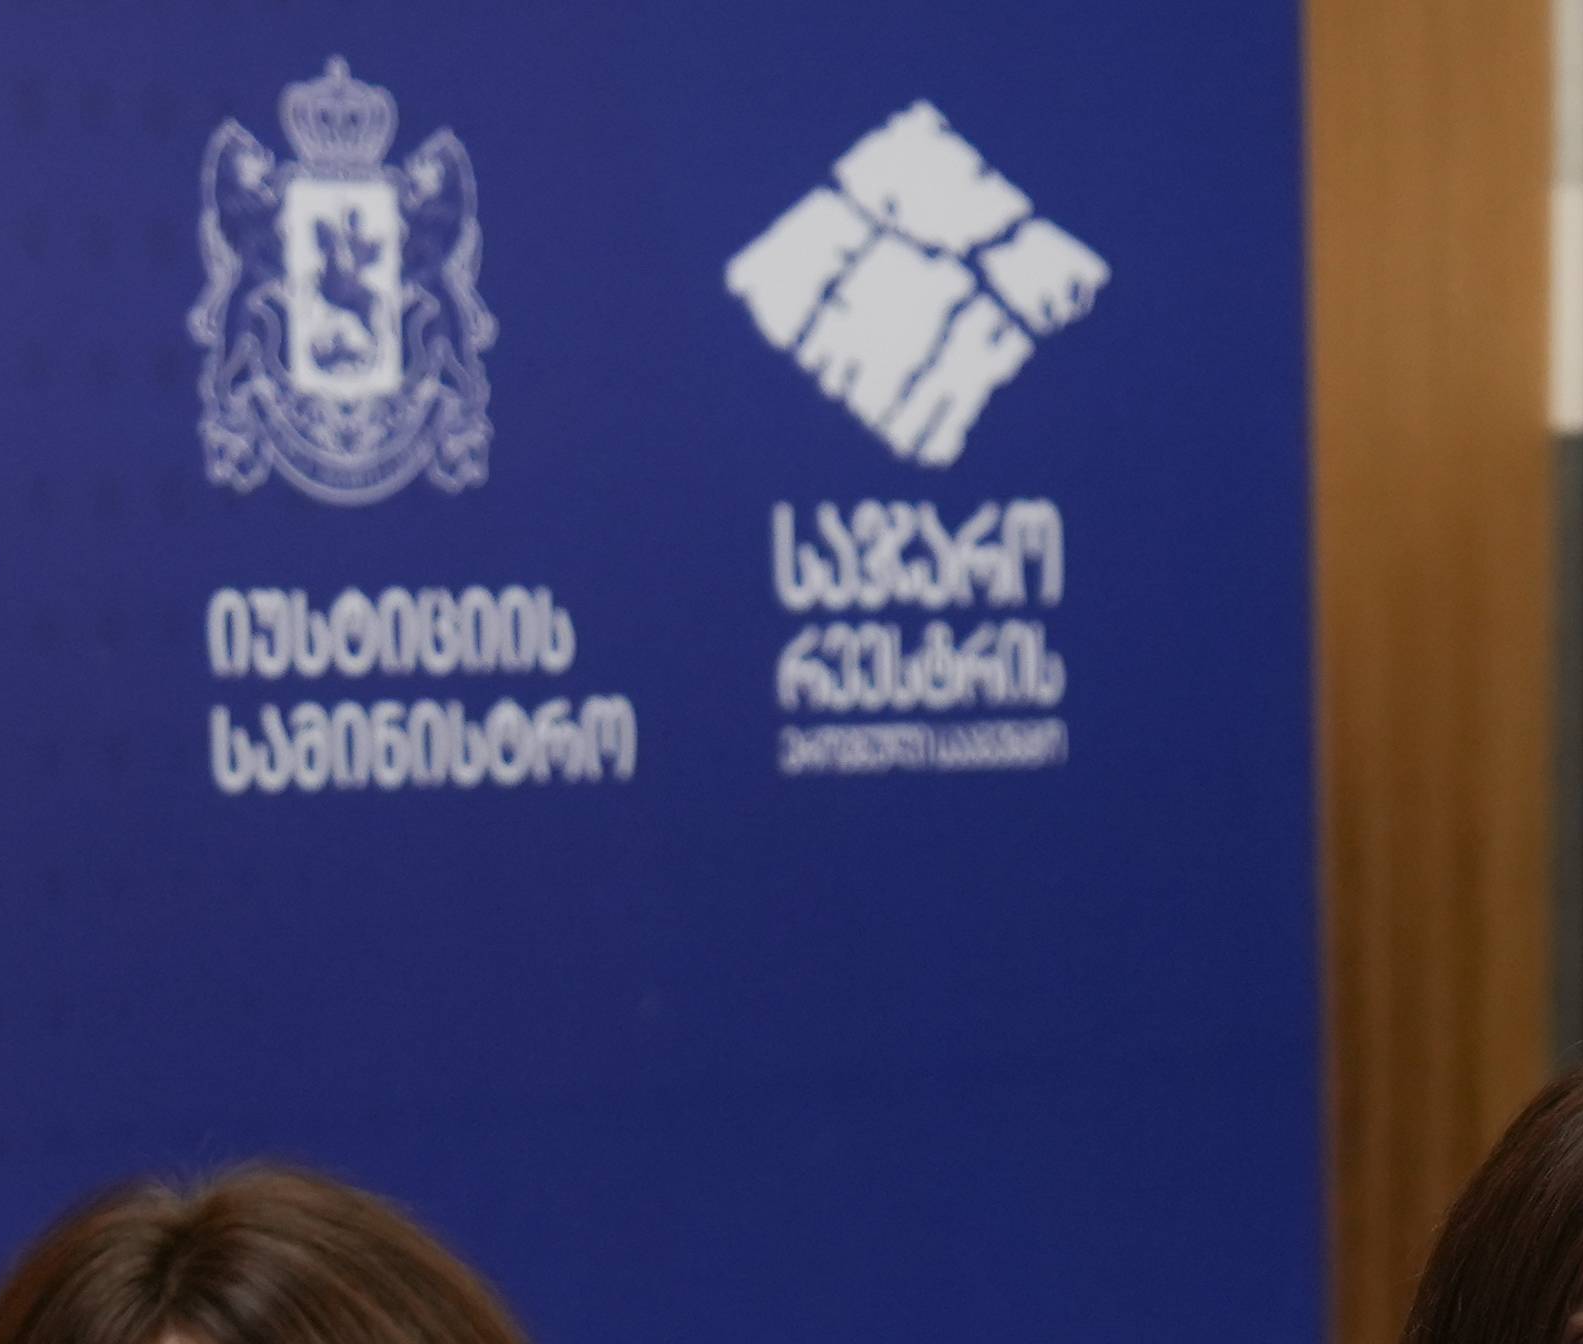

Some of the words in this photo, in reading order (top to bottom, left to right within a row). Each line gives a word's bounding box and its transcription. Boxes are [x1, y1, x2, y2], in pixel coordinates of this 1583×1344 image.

[772, 498, 1064, 611] საჯარო
[206, 585, 576, 679] იუსტიციის
[775, 621, 1066, 711] რეესტრის
[209, 695, 637, 793] სამინისტრო
